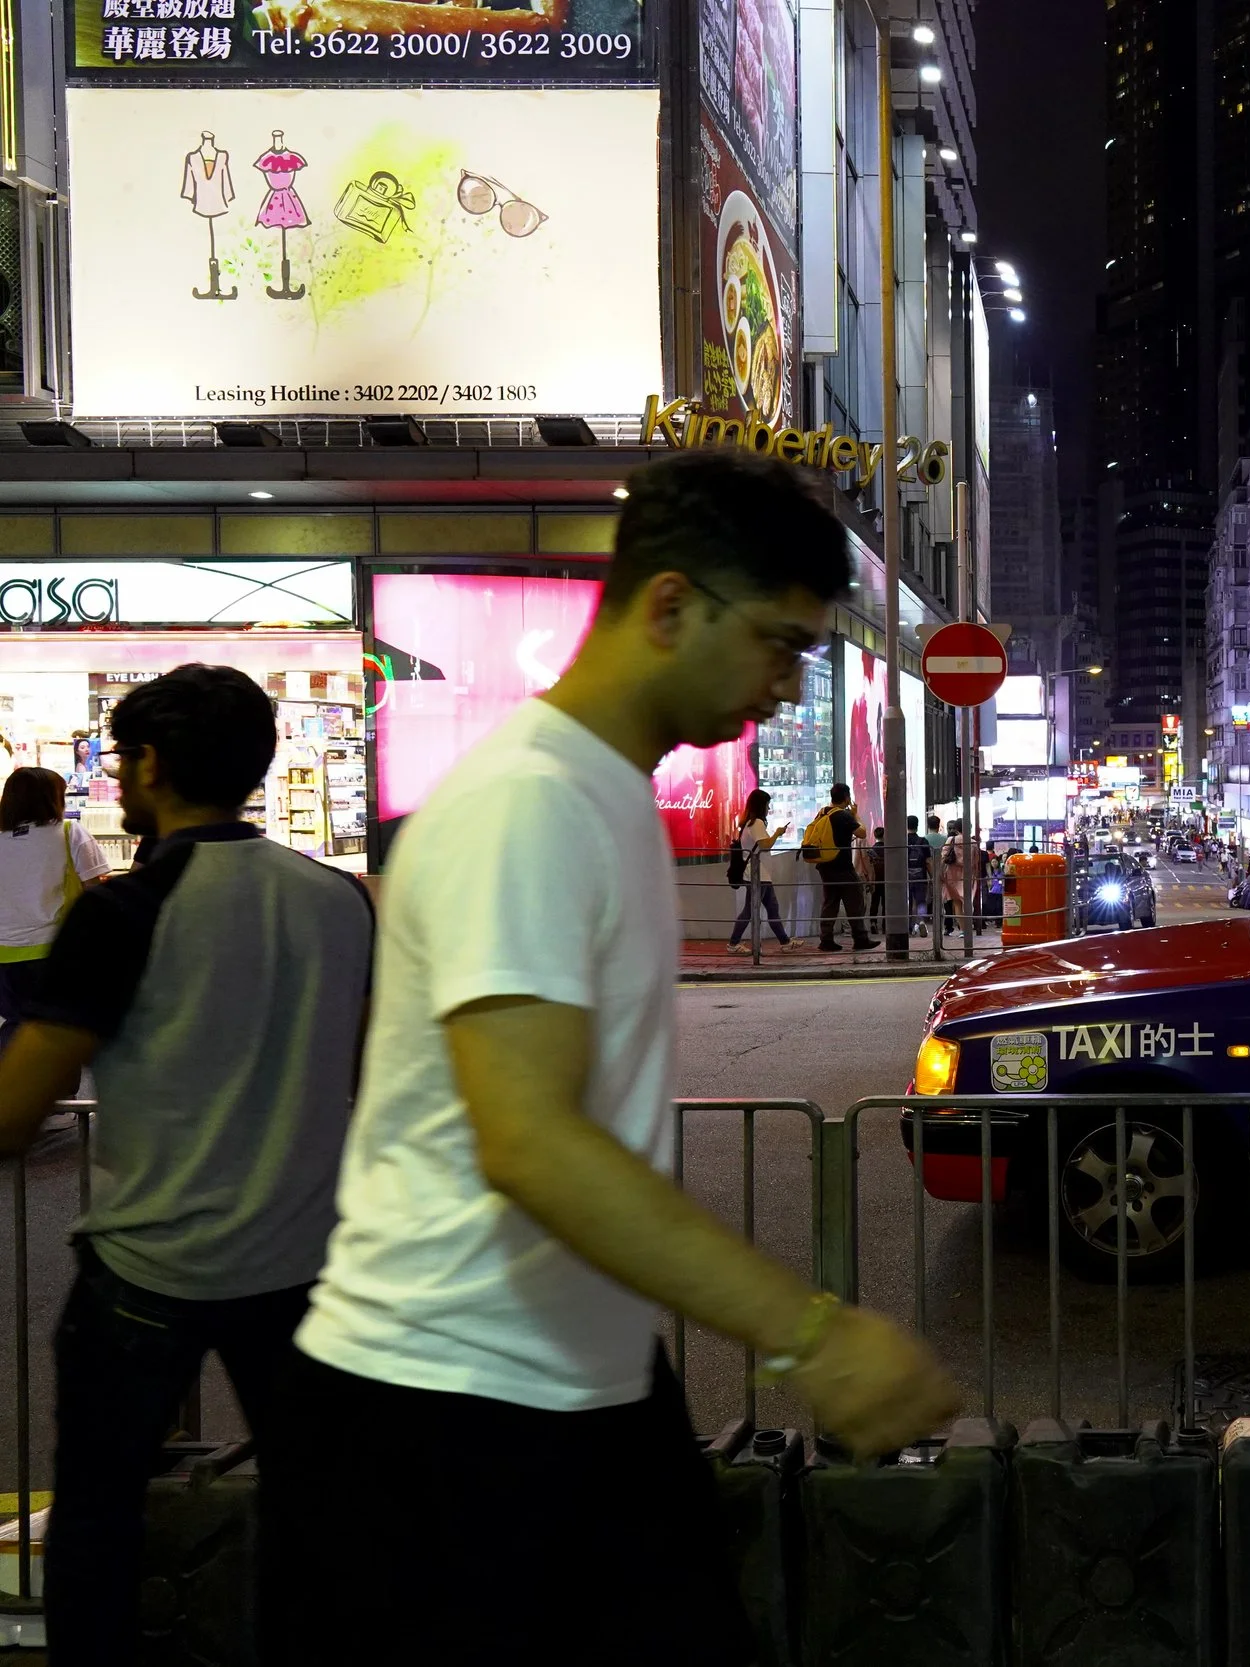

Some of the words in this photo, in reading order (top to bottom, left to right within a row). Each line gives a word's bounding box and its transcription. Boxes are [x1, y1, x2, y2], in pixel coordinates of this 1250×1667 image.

[103, 27, 232, 60] 華麗登場
[252, 28, 300, 54] Tel:
[310, 30, 379, 57] 3622
[481, 30, 550, 58] 3622
[560, 33, 632, 58] 3009
[195, 385, 266, 406] Leasing
[271, 385, 340, 401] Hotline
[353, 385, 394, 401] 3402
[397, 385, 438, 401] 2202
[453, 385, 493, 401] 3402
[497, 385, 537, 401] 1803
[639, 394, 885, 488] Kimberley
[896, 435, 949, 486] 26
[106, 673, 128, 682] EYE
[1052, 1023, 1132, 1060] TAXI
[1139, 1022, 1215, 1058] 的士
